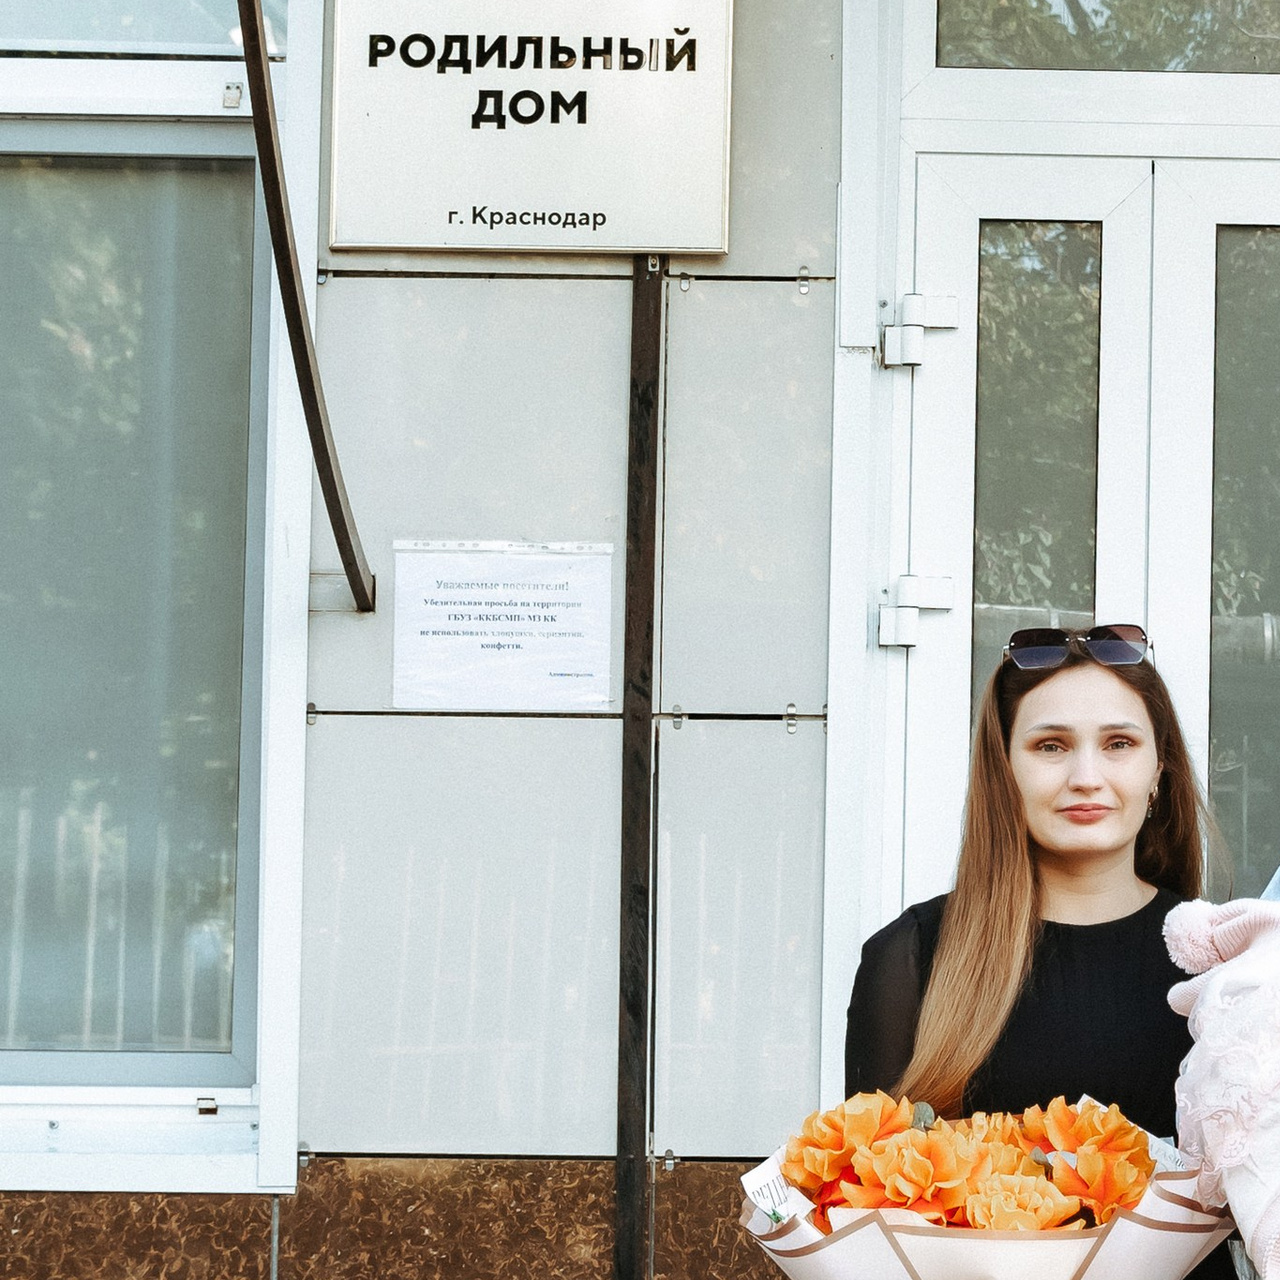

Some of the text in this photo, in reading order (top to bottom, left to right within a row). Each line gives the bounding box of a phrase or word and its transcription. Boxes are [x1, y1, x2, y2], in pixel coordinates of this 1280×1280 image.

[368, 27, 698, 75] РОДИЛЬНЫЙ
[471, 89, 588, 130] ДОМ
[448, 206, 607, 231] г. Краснодар
